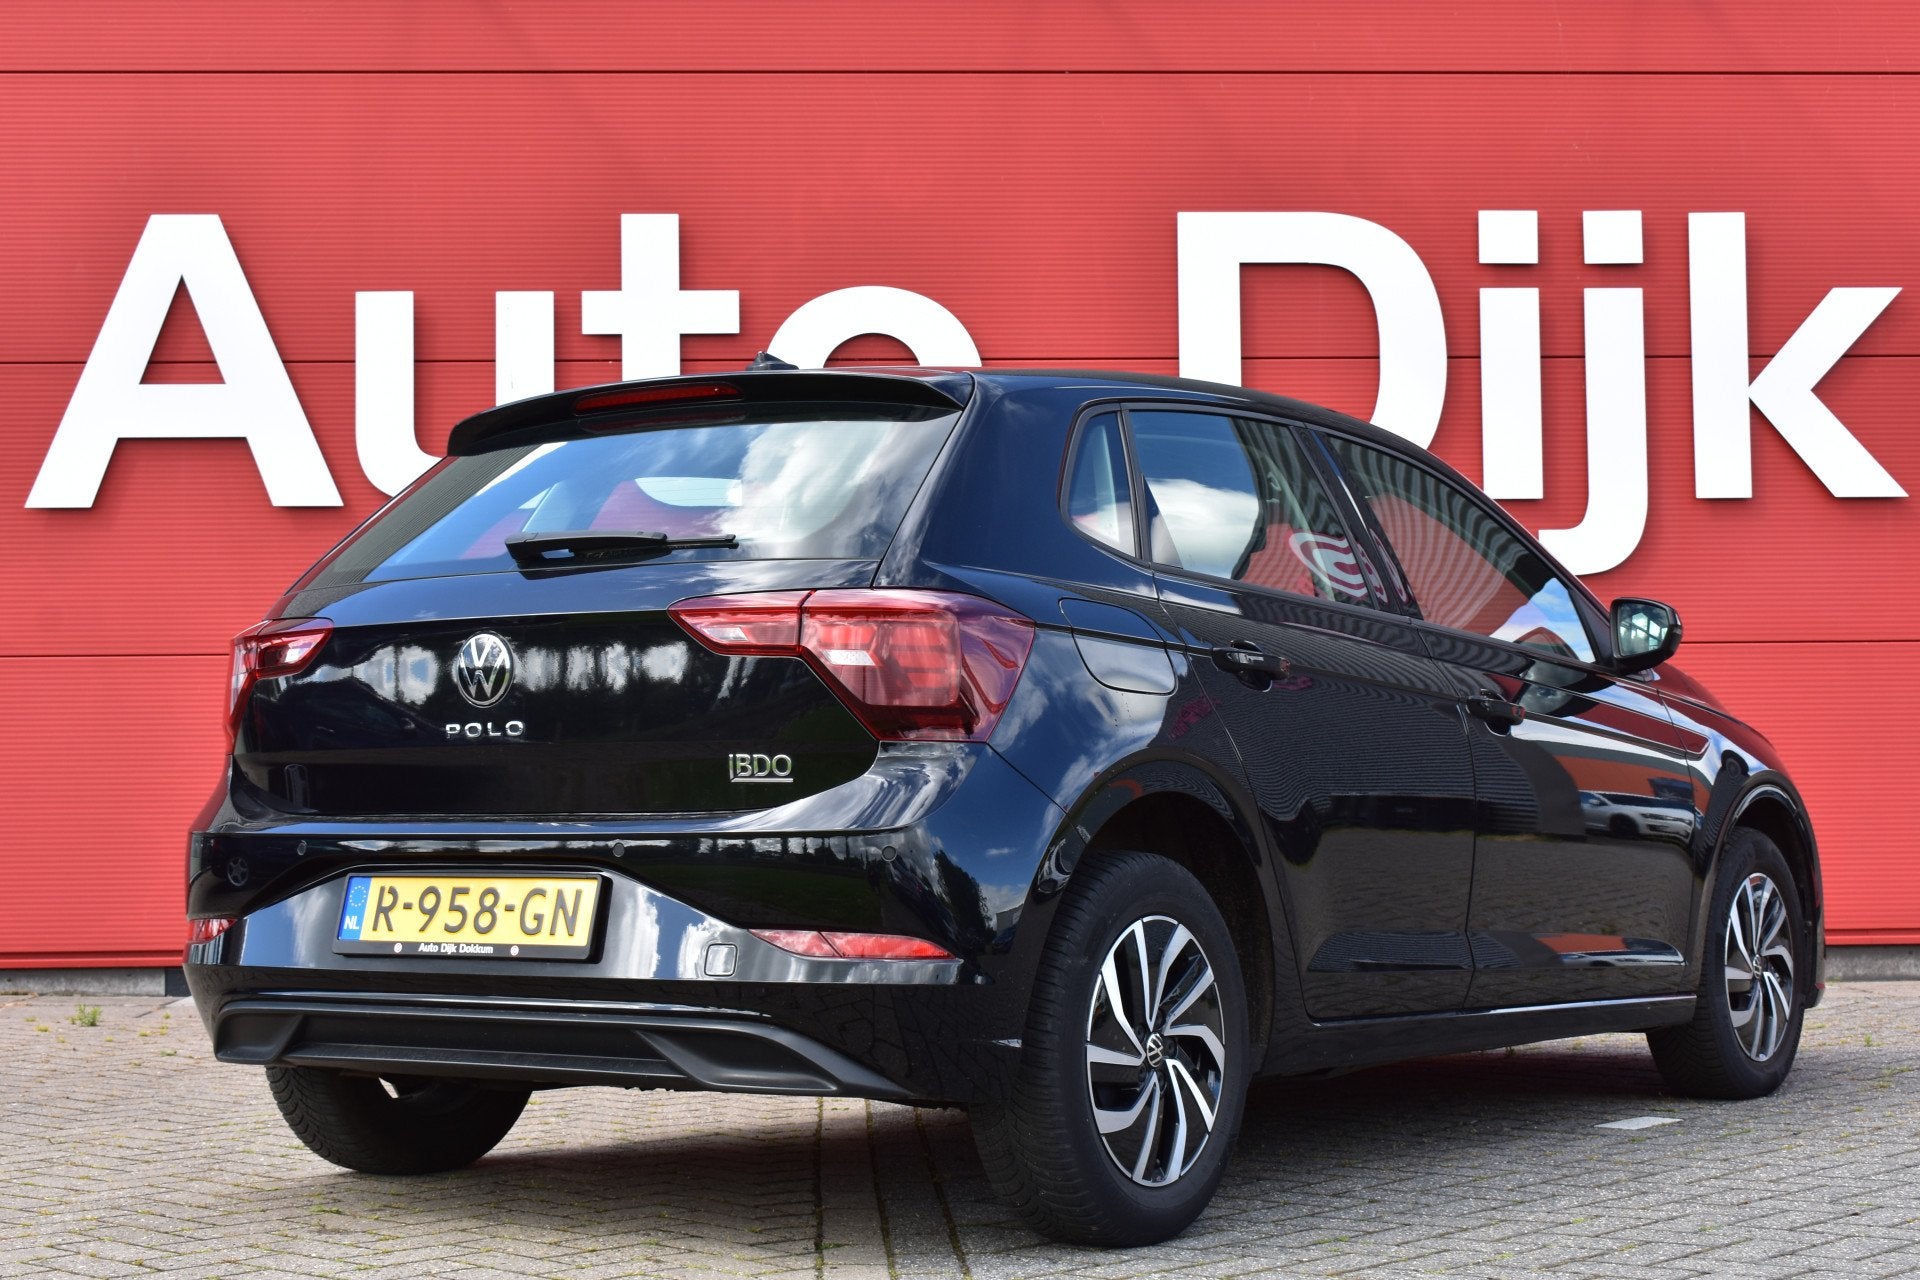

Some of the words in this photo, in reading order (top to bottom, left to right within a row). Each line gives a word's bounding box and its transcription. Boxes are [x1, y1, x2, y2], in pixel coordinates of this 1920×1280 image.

[1176, 209, 1910, 576] Dijk
[445, 720, 524, 739] POLO
[372, 885, 582, 936] R-958-GN
[344, 915, 360, 930] NL
[418, 942, 439, 953] Auto
[440, 943, 456, 955] Dijk
[459, 943, 494, 954] Dokkum
